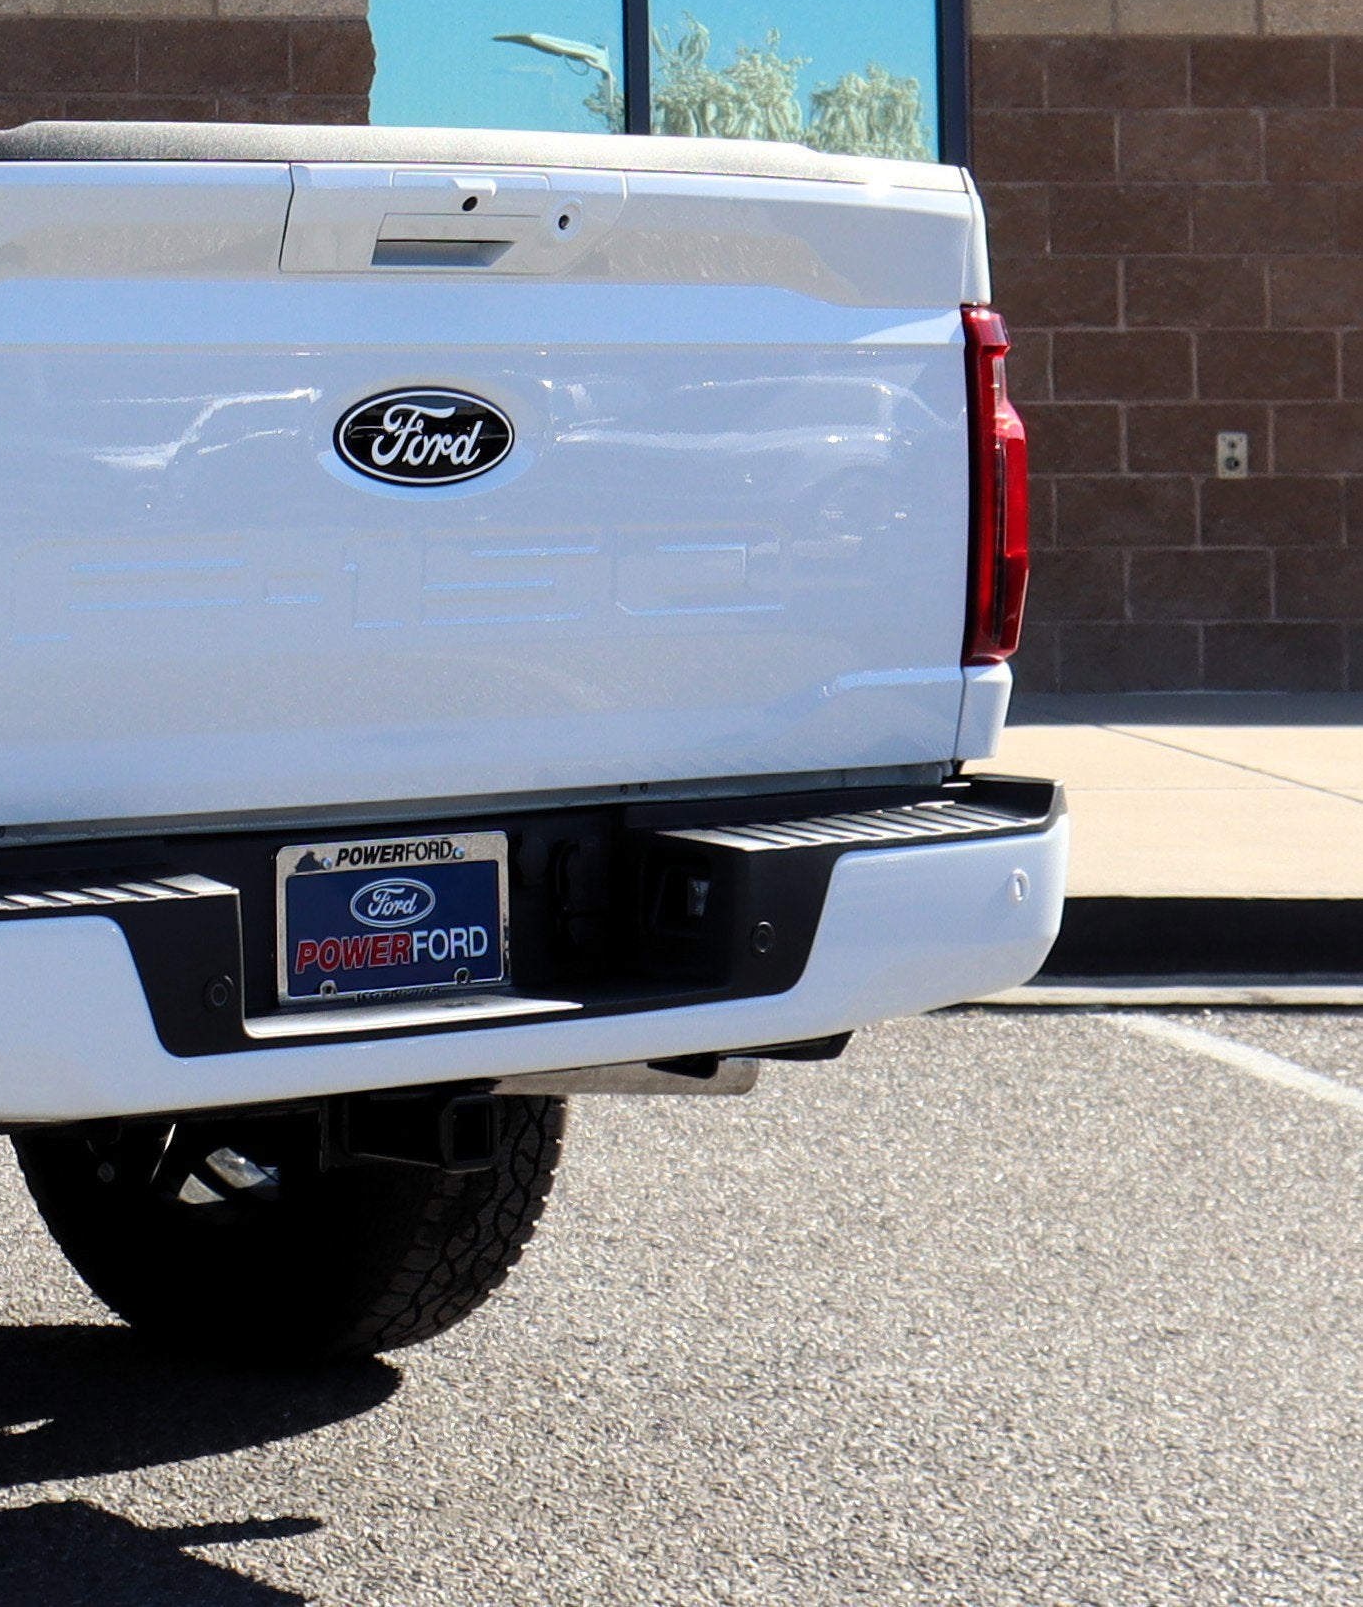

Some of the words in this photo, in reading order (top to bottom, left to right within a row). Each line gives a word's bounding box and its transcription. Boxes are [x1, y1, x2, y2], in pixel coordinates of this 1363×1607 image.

[371, 403, 482, 467] Ford
[367, 887, 418, 917] Ford
[294, 926, 489, 975] POWERFORD
